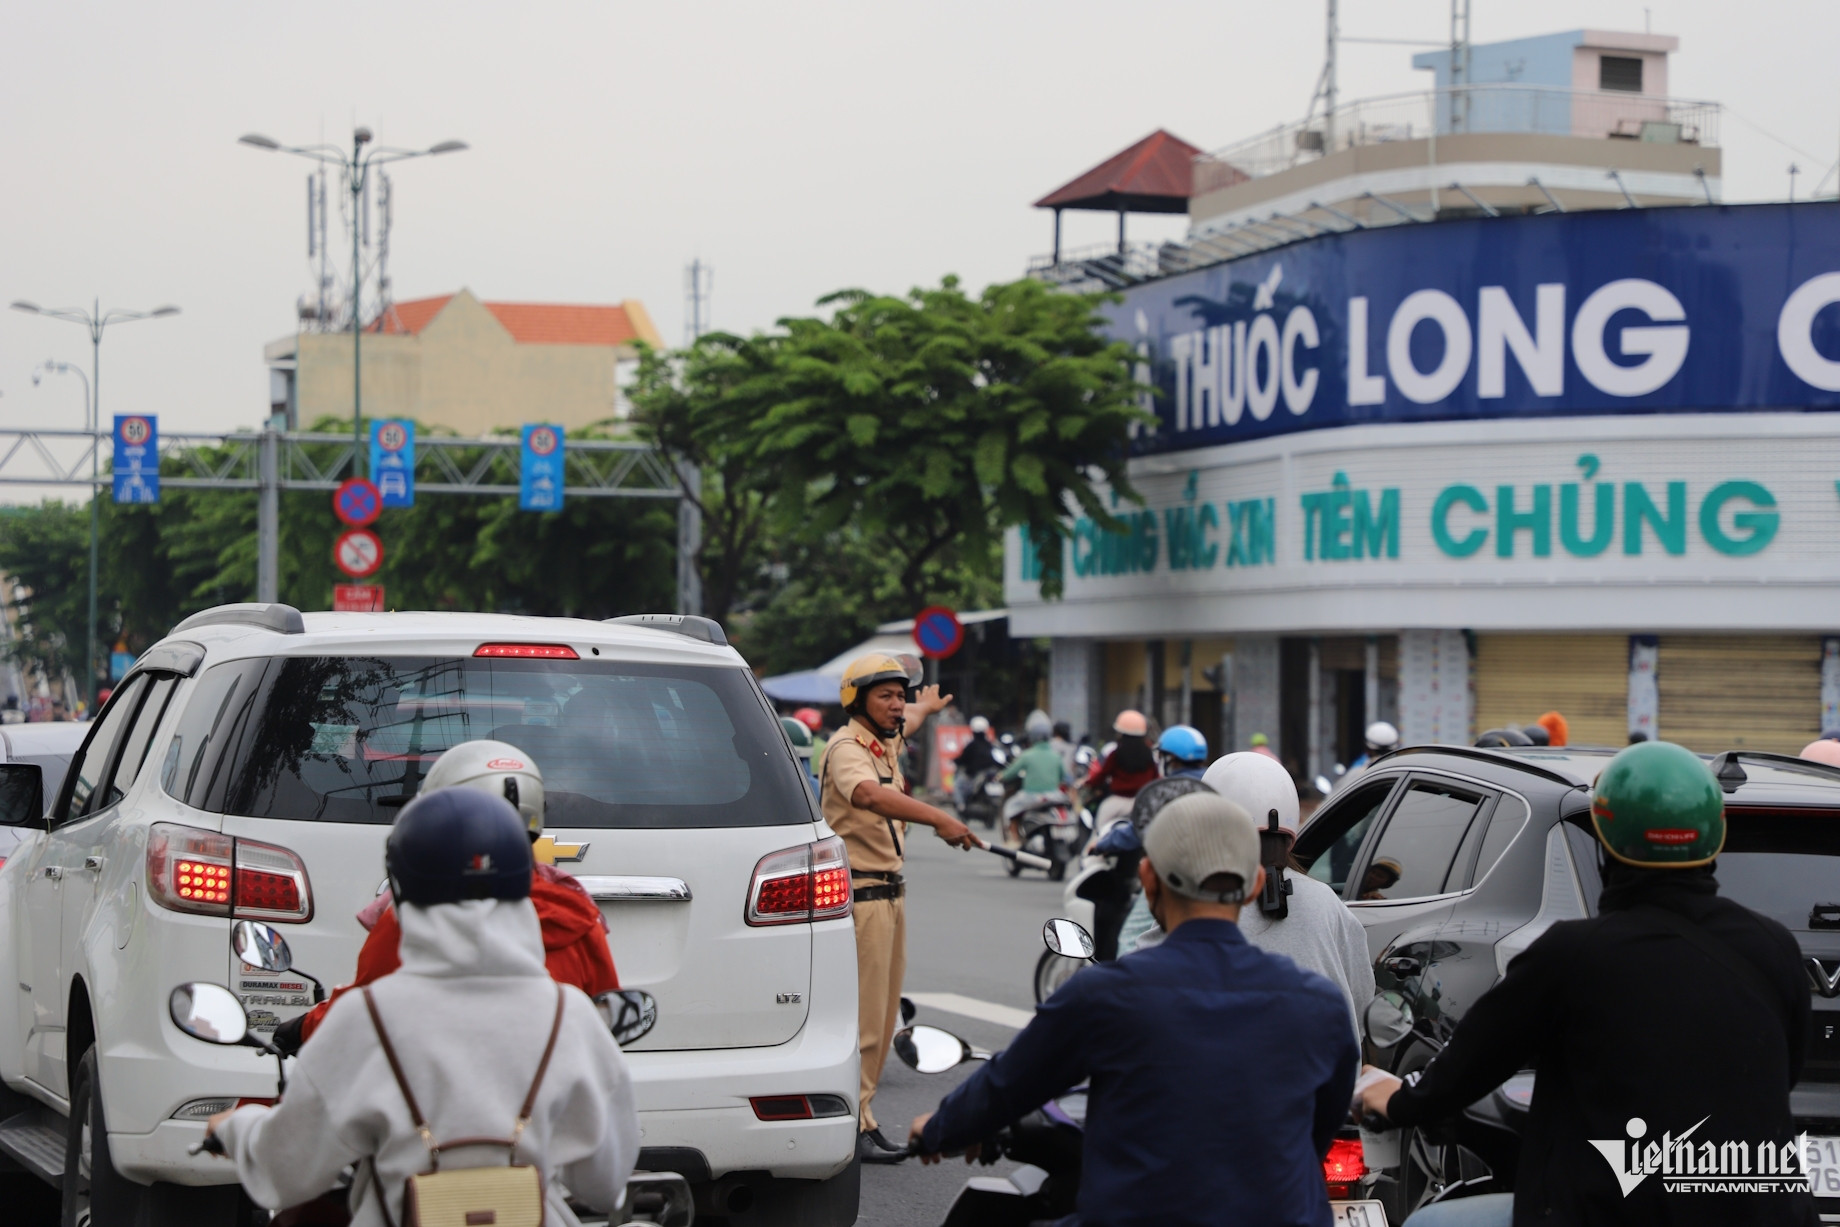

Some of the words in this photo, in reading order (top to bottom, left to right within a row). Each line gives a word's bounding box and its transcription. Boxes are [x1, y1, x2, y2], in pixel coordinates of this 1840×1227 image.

[1171, 264, 1320, 432] THUỐC
[1347, 278, 1690, 406] LONG
[1300, 470, 1401, 562] TIÊM
[1430, 453, 1780, 558] CHỦNG
[1227, 497, 1275, 567] XIN
[240, 994, 317, 1007] TRAILBL
[242, 981, 278, 989] DURAMAX
[279, 982, 304, 990] DIESEL
[776, 993, 802, 1004] LTZ
